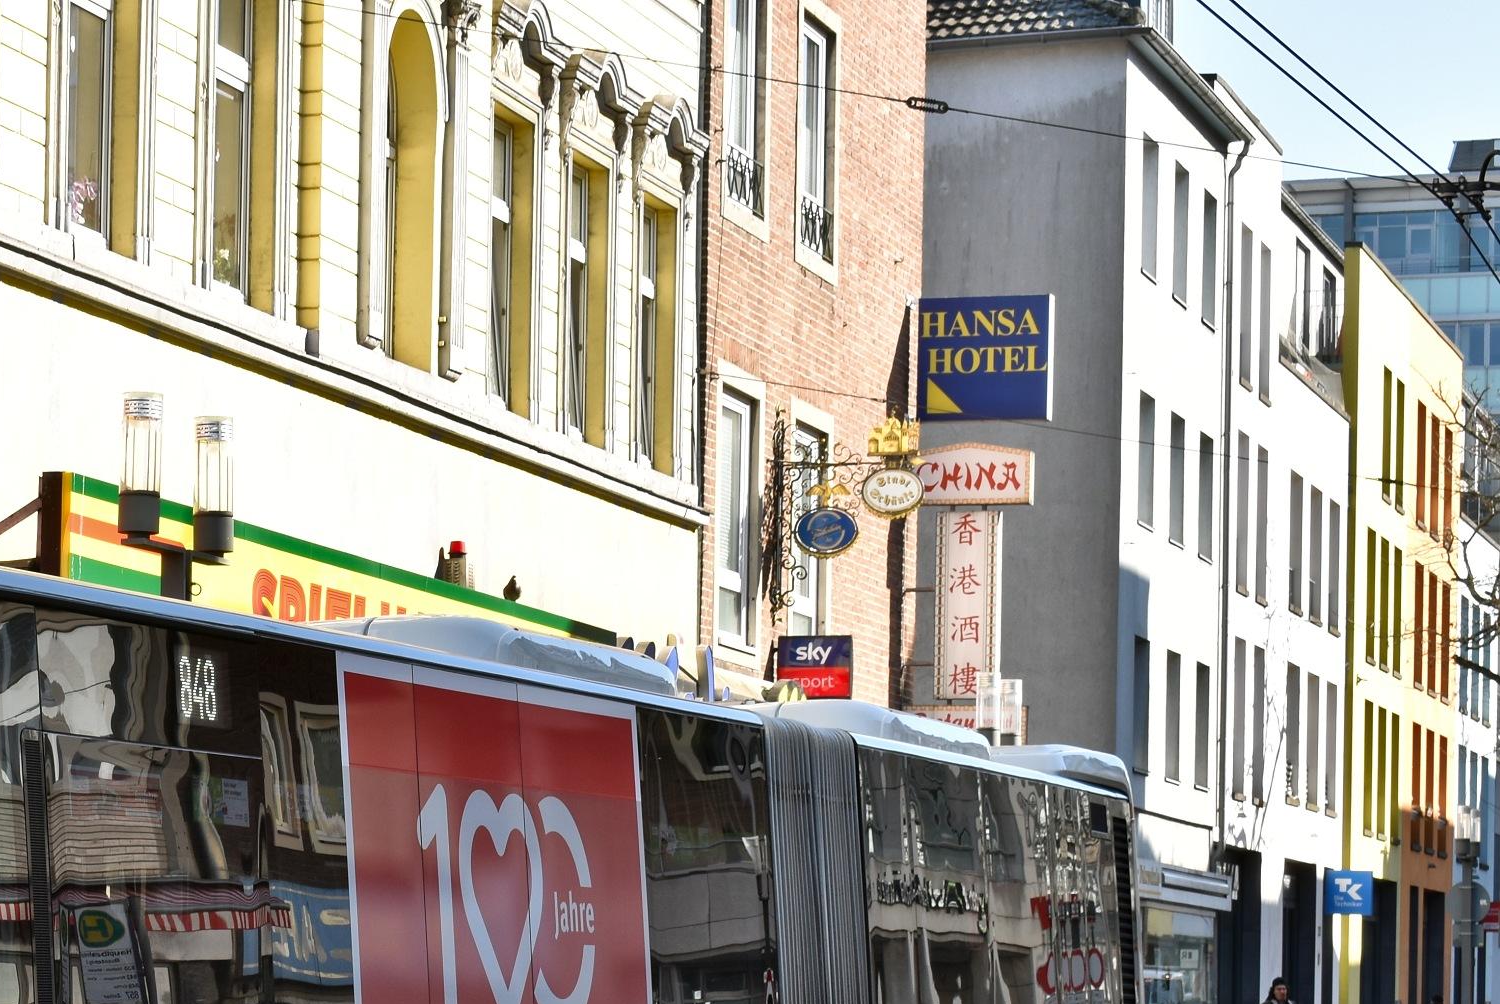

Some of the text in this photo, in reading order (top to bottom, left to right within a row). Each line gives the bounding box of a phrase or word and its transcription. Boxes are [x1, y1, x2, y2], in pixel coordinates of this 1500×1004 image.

[921, 309, 1041, 338] HANSA
[928, 345, 1048, 375] HOTEL
[916, 461, 1021, 492] CHINA
[795, 641, 833, 665] sky
[179, 655, 217, 721] 848
[1334, 878, 1363, 901] TK
[553, 889, 596, 940] Jahre
